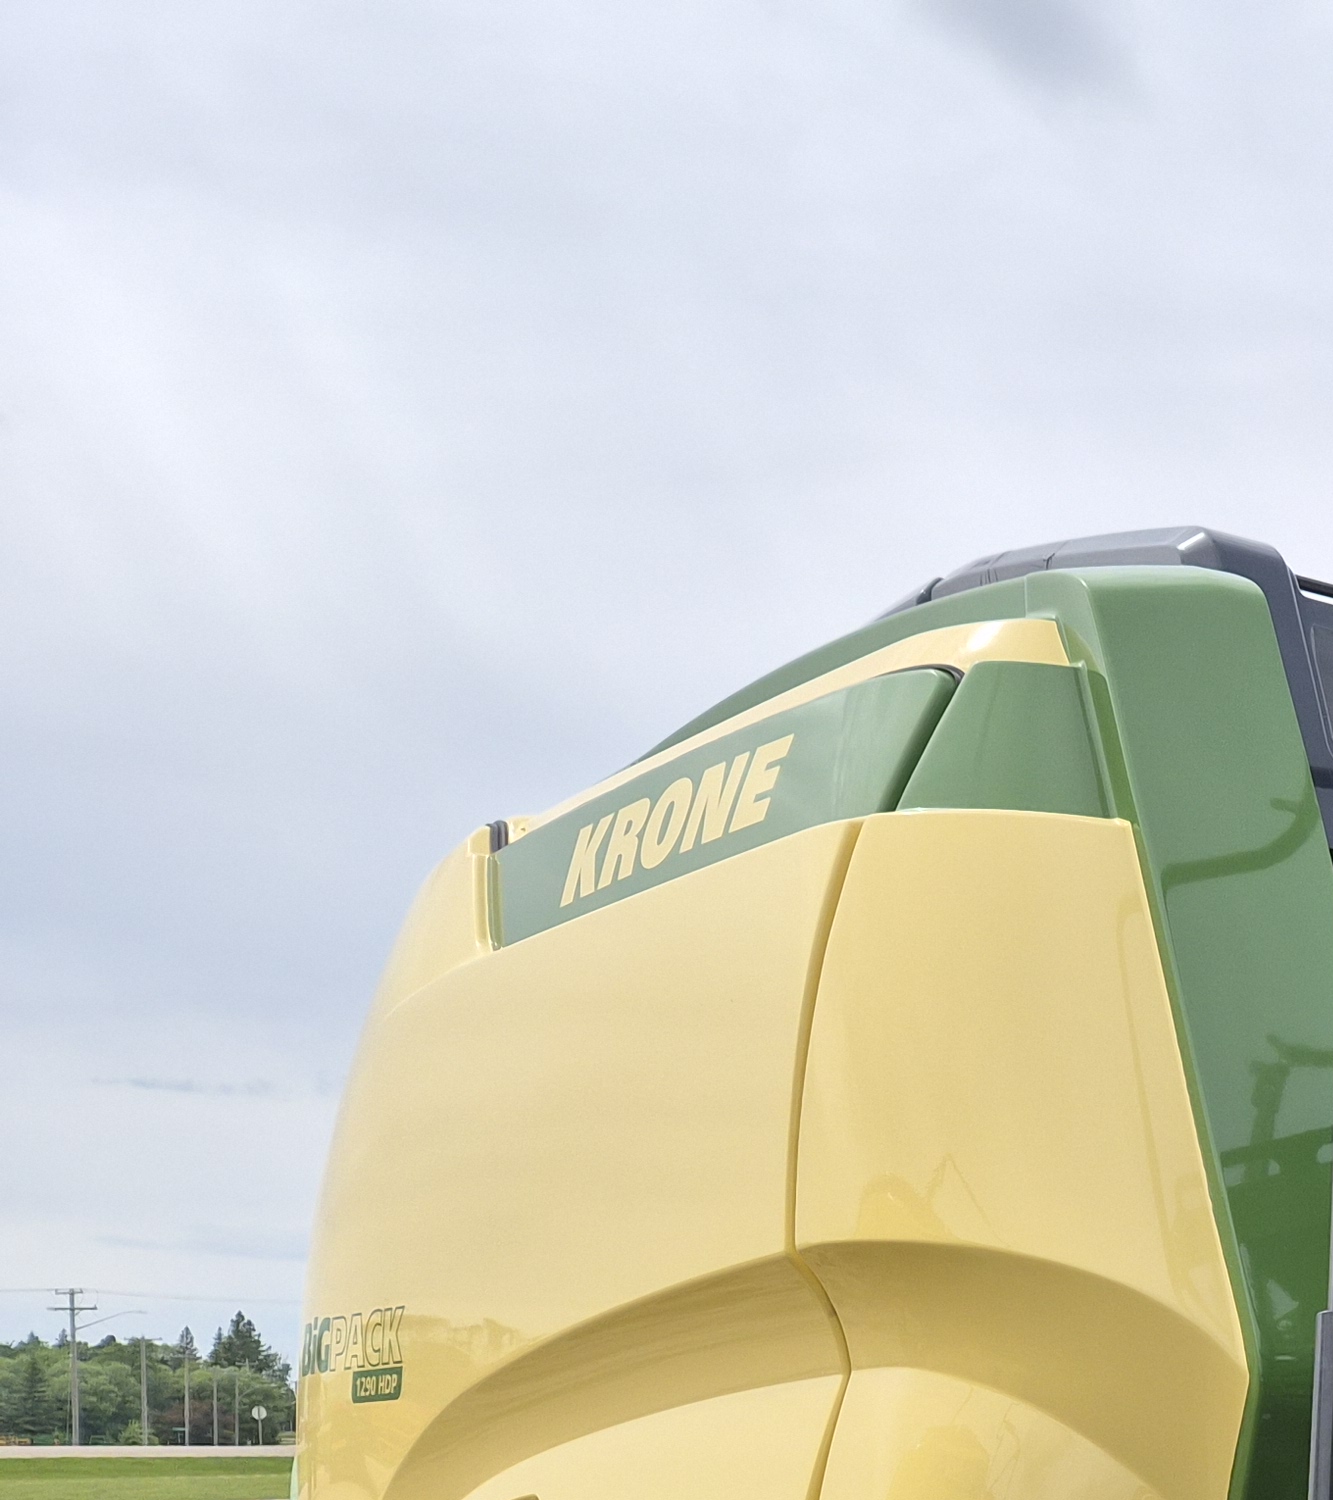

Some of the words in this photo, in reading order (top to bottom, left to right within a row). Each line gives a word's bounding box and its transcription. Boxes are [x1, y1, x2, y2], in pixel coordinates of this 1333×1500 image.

[559, 732, 795, 909] KRONE
[356, 1376, 376, 1397] 1290
[378, 1374, 397, 1394] HDP
